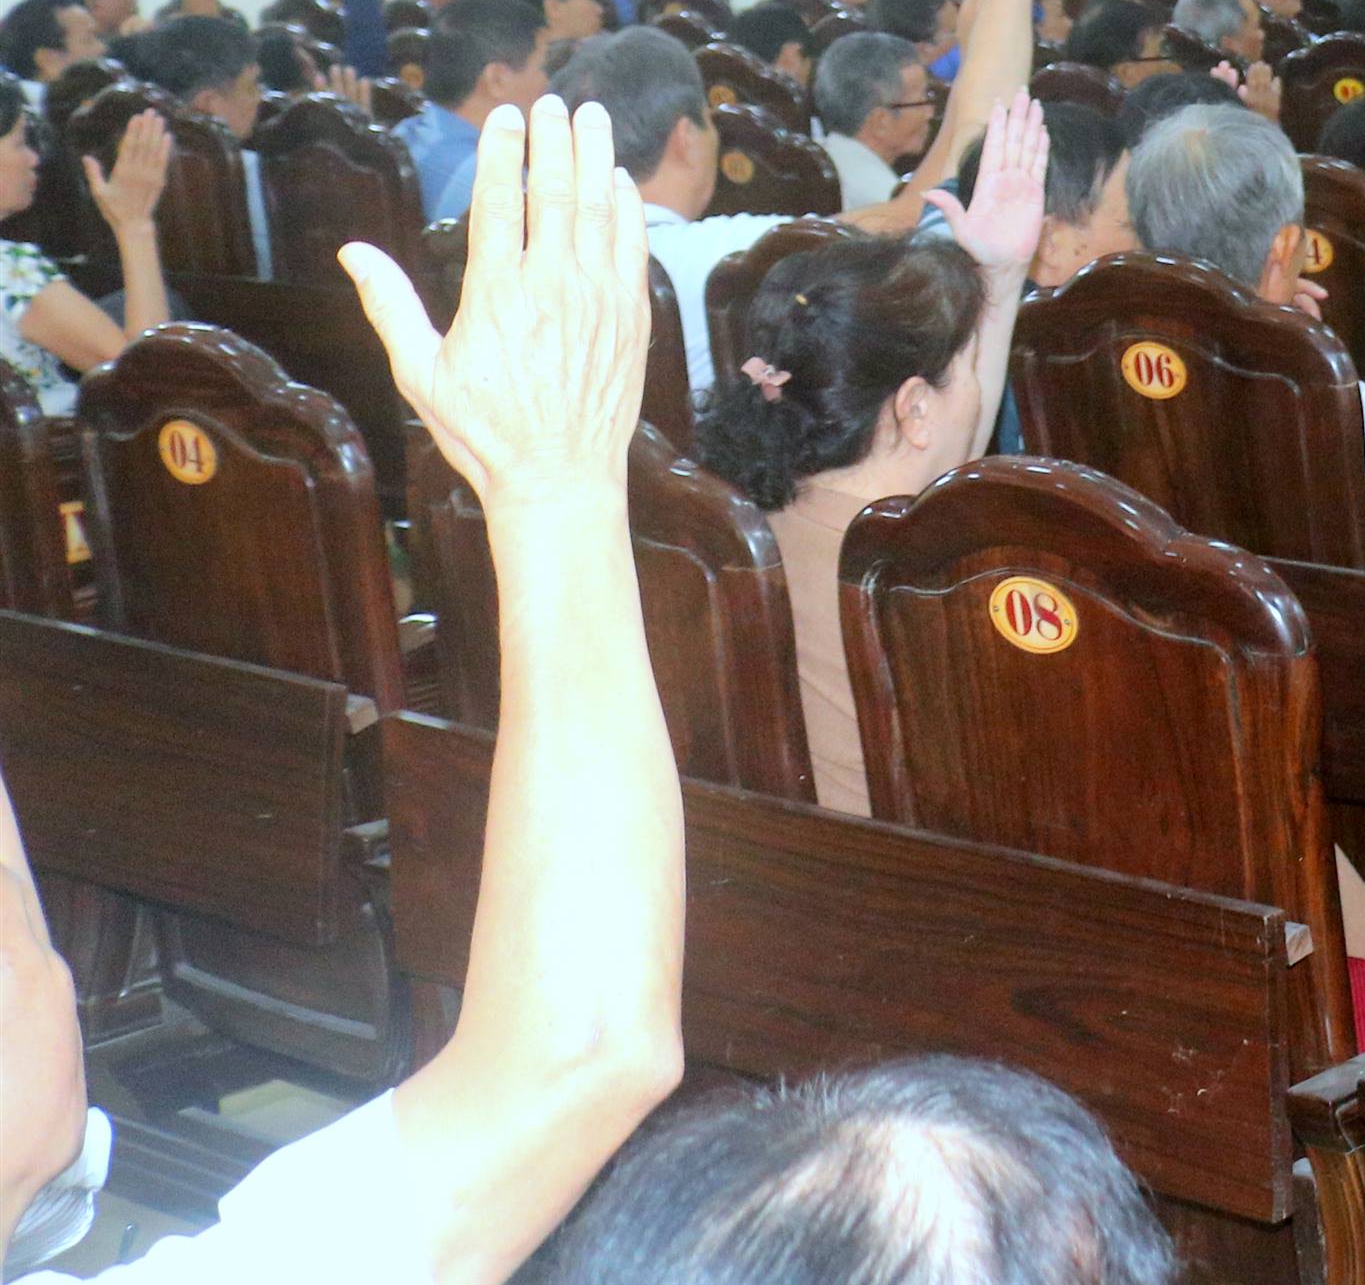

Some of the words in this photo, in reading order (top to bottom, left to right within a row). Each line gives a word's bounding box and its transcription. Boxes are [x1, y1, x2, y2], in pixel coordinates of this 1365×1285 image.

[1132, 352, 1173, 389] 06
[167, 432, 206, 474] 04
[1006, 588, 1064, 641] 08
